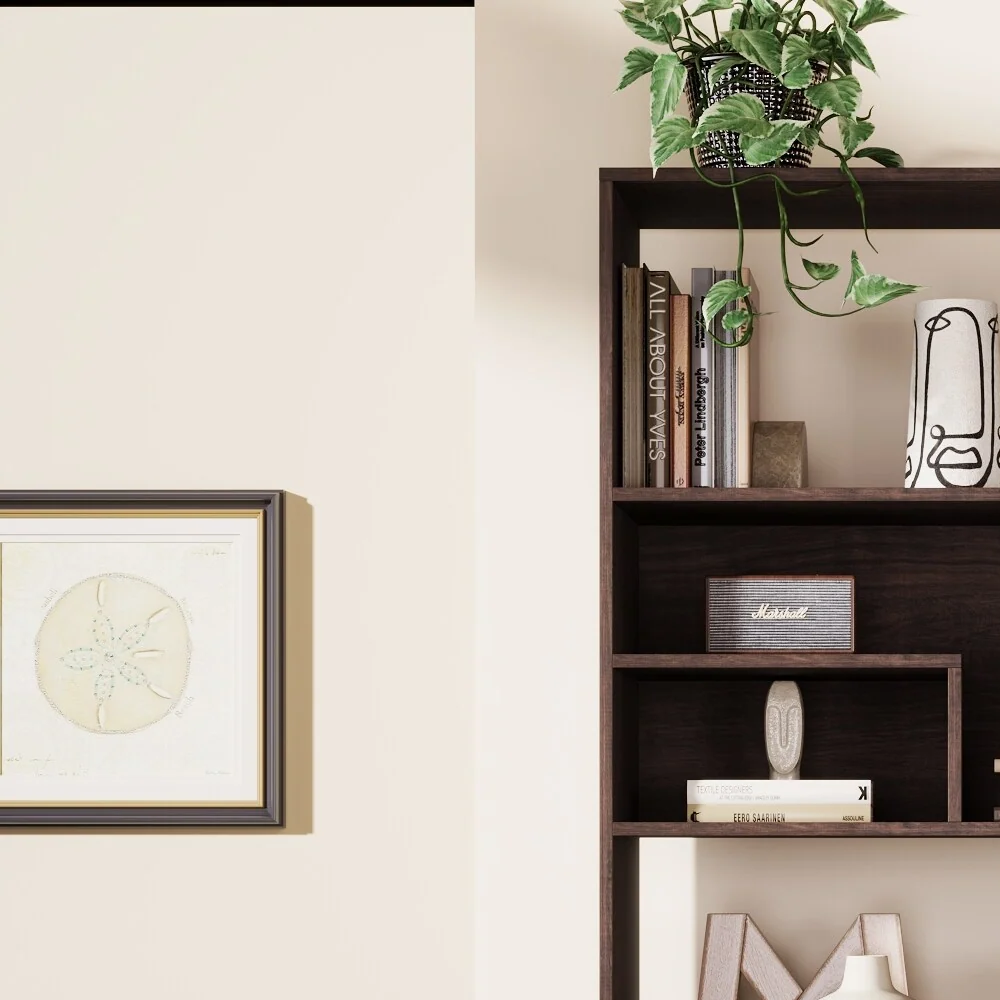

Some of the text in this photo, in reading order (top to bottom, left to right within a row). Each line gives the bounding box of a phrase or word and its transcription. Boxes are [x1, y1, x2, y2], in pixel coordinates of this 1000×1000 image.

[649, 281, 666, 461] ALL ABOUT YVES
[694, 367, 709, 467] Peter Lindbergh
[751, 602, 810, 619] Marshall
[696, 785, 753, 794] TEXTILE DESIGNERS
[733, 812, 786, 822] EERO SAARINEN
